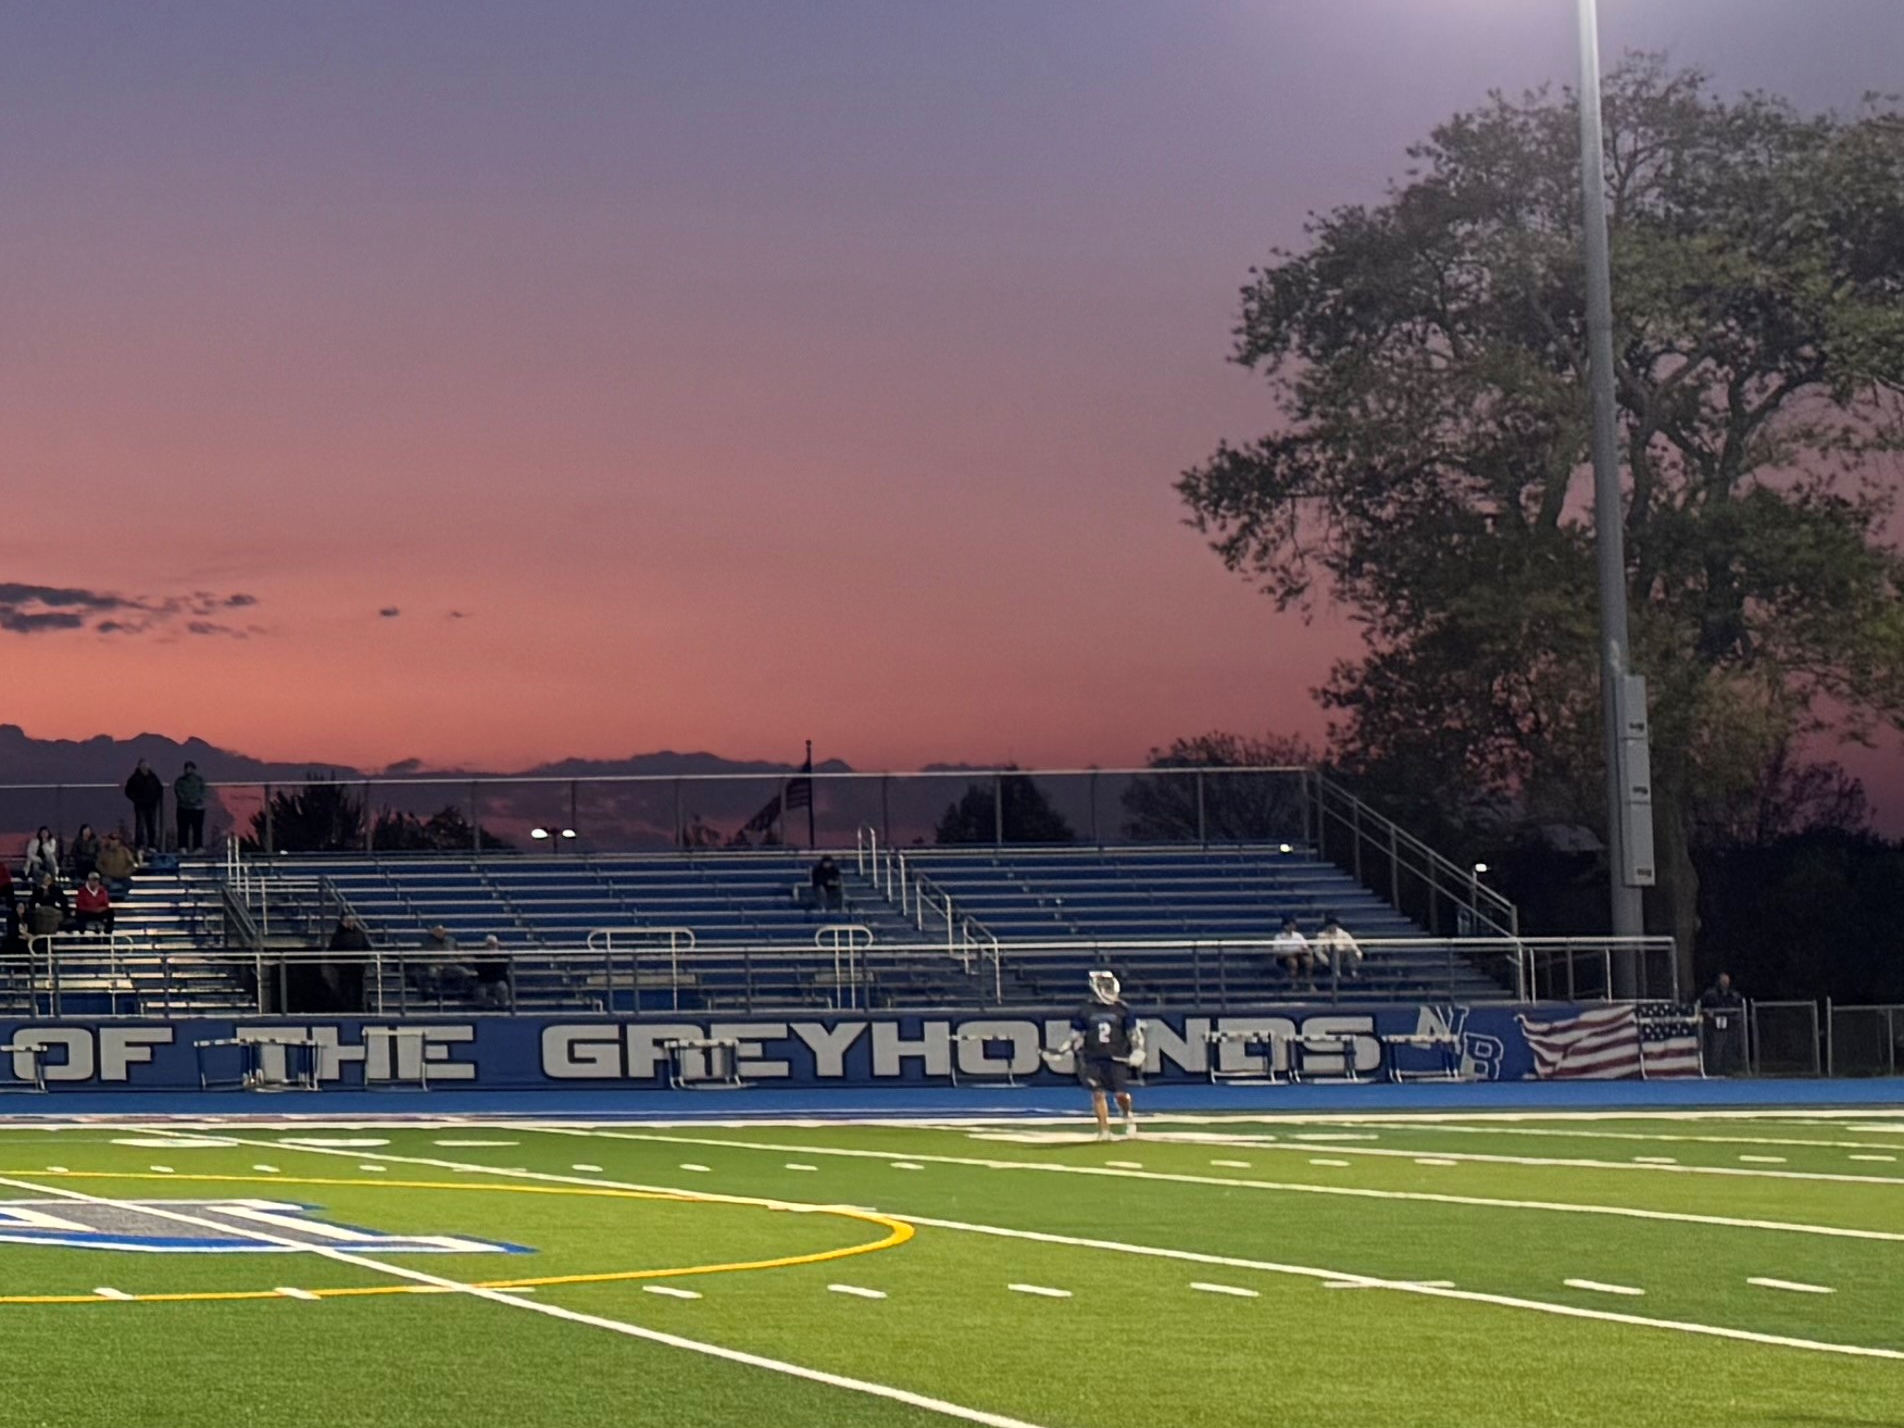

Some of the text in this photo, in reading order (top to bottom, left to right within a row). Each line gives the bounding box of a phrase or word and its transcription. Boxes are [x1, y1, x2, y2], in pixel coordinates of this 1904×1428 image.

[1097, 1021, 1111, 1043] 2
[12, 1026, 174, 1082] OF
[235, 1024, 475, 1080] THE
